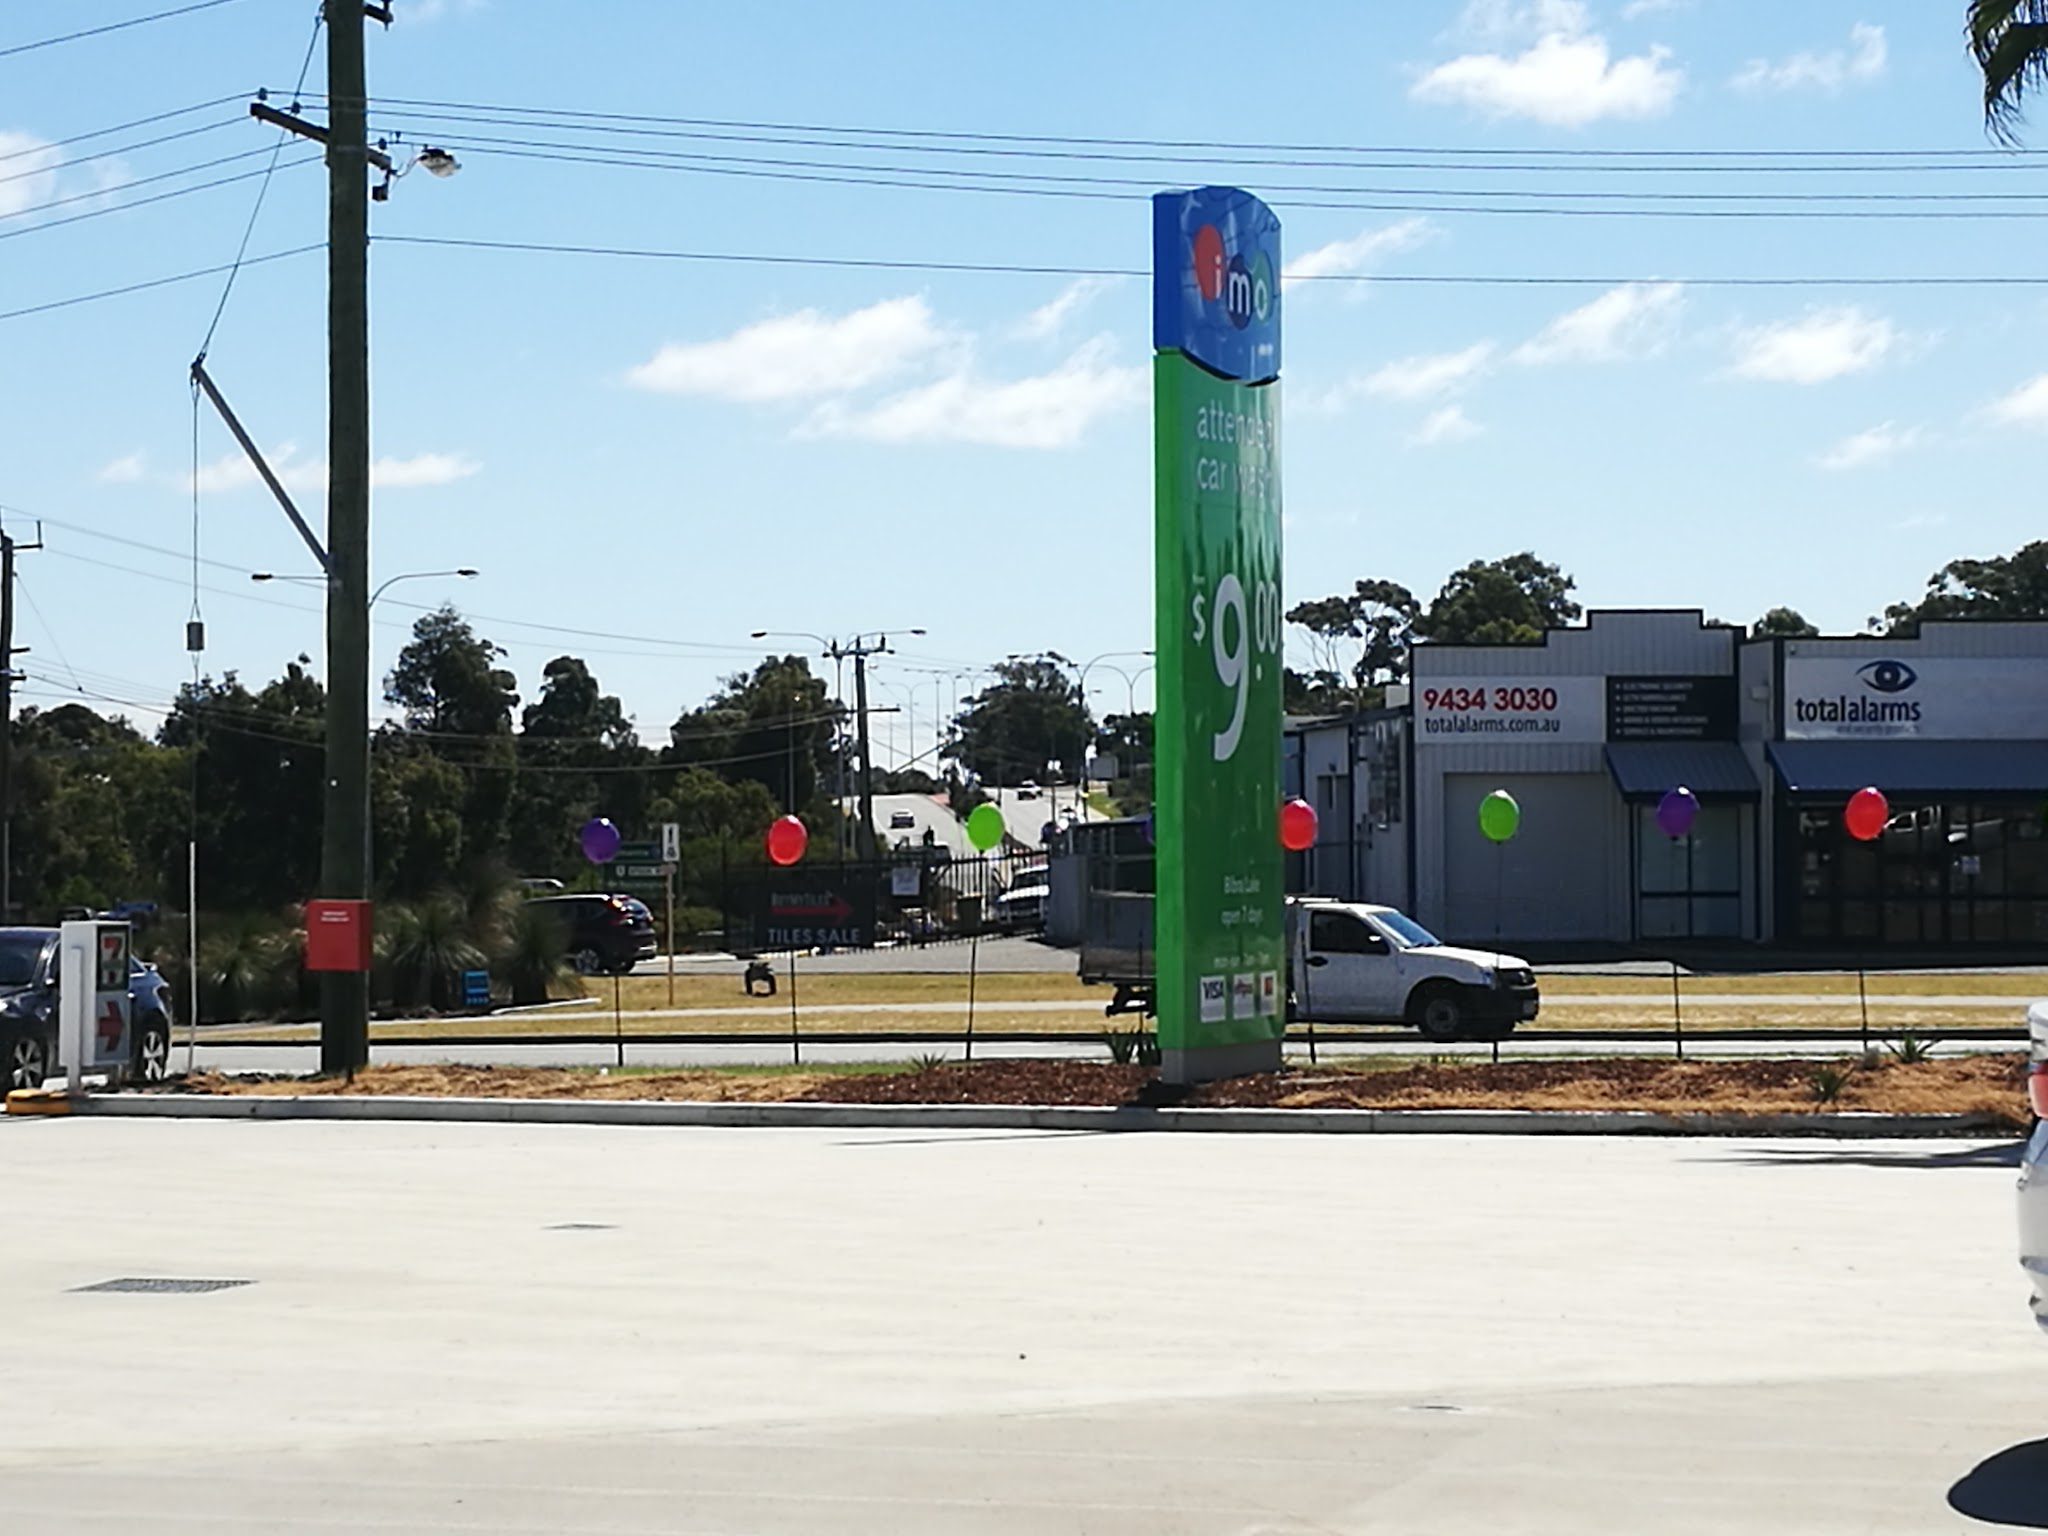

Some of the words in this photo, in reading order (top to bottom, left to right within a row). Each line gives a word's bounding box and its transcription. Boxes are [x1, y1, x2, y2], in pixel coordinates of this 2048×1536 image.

[1213, 255, 1267, 320] imo
[1197, 457, 1227, 490] car
[1423, 688, 1487, 711] 9434
[1494, 687, 1558, 711] 3030
[1795, 695, 1921, 722] totalalarms
[1425, 716, 1561, 733] totalalarms.com.au
[768, 928, 812, 943] TILES
[816, 928, 860, 943] SALE
